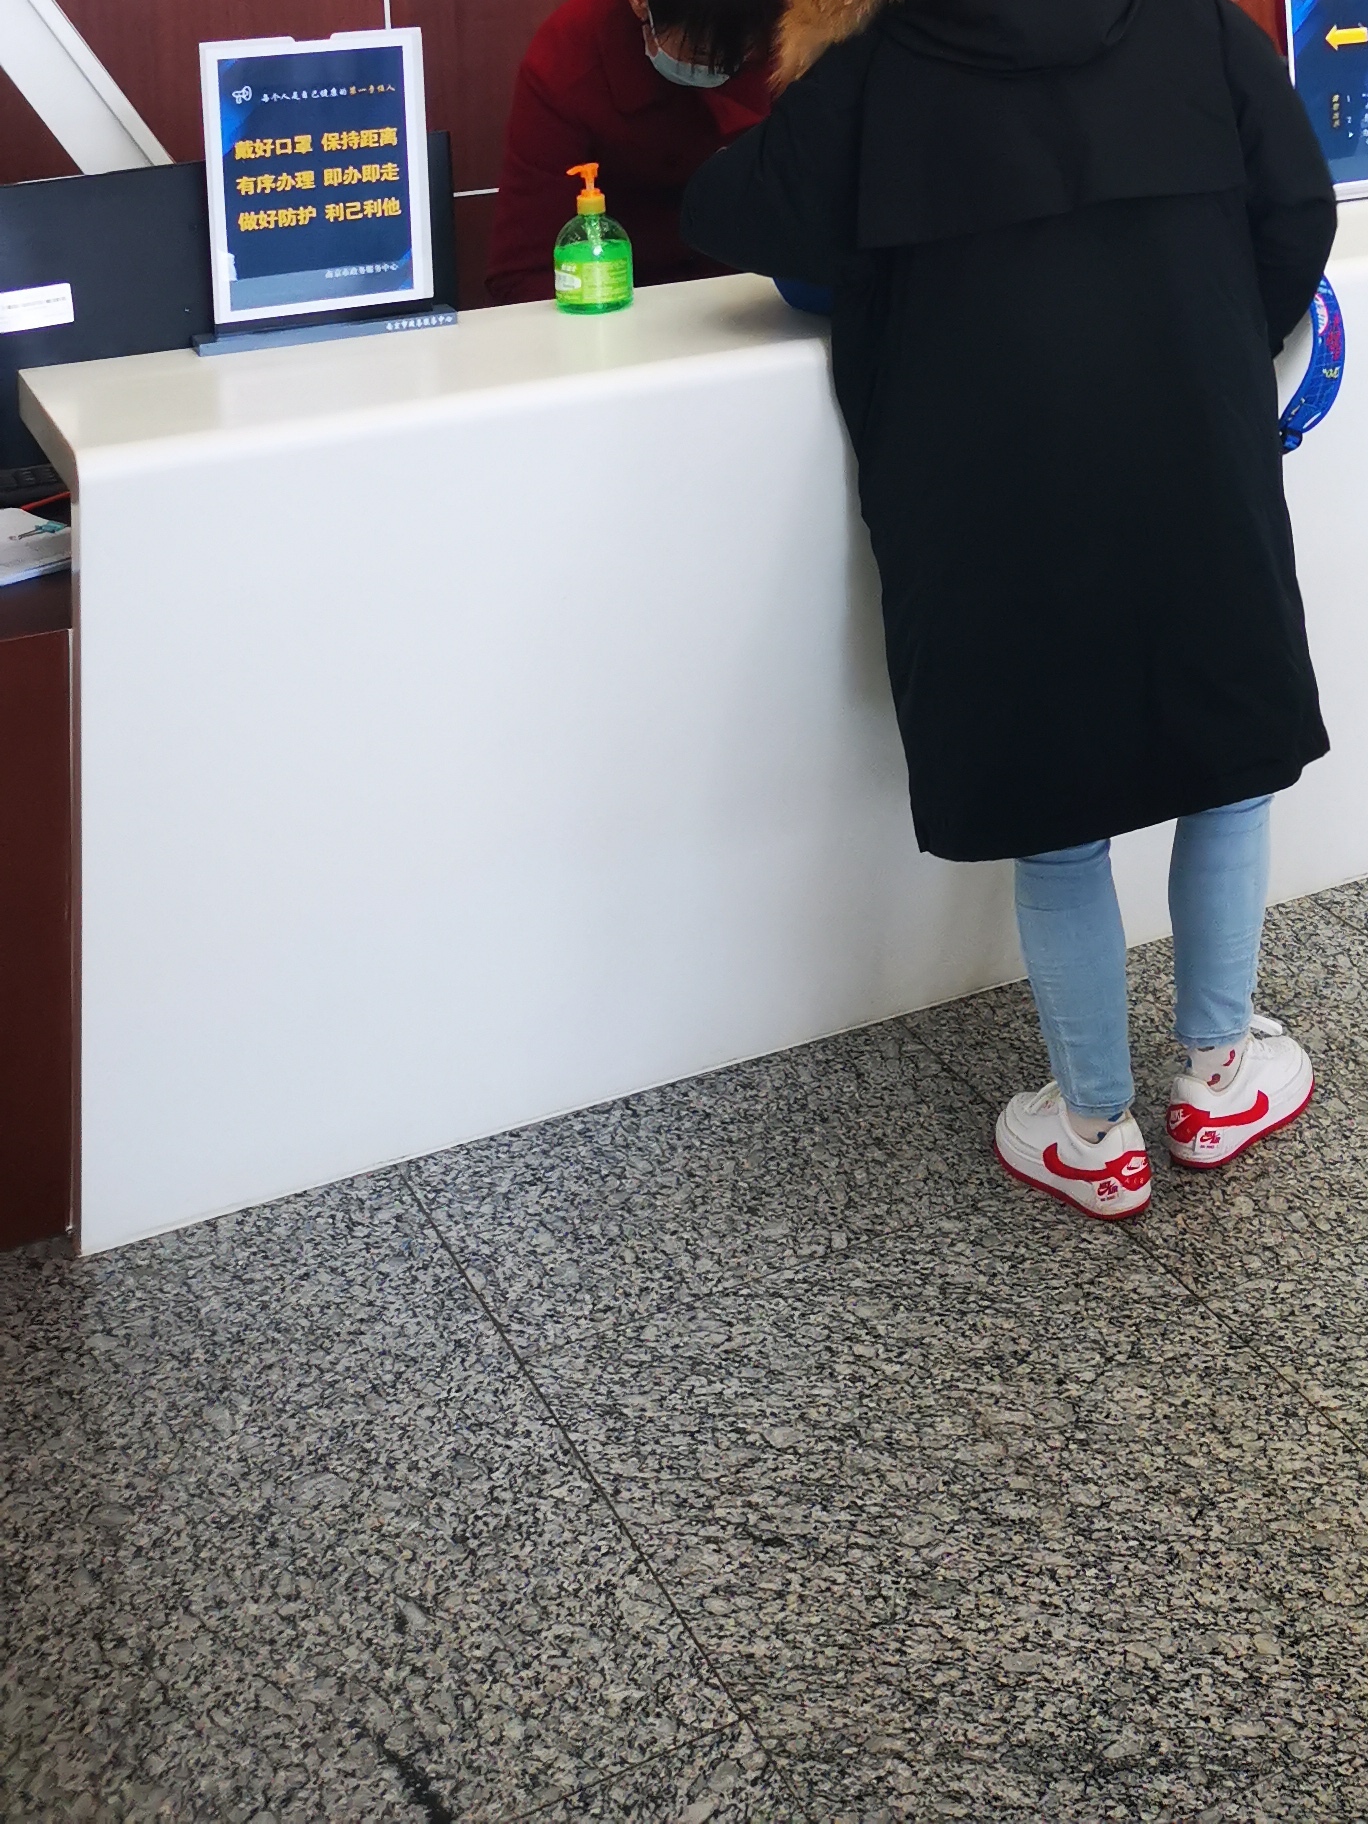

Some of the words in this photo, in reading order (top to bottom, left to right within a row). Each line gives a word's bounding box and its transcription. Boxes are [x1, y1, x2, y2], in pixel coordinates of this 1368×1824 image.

[234, 135, 314, 161] 戴好口罩
[321, 127, 398, 152] 保持距离
[236, 170, 316, 196] 有序办理
[323, 162, 400, 188] 即办即走
[238, 205, 317, 232] 做好防护
[325, 197, 402, 223] 利己利他
